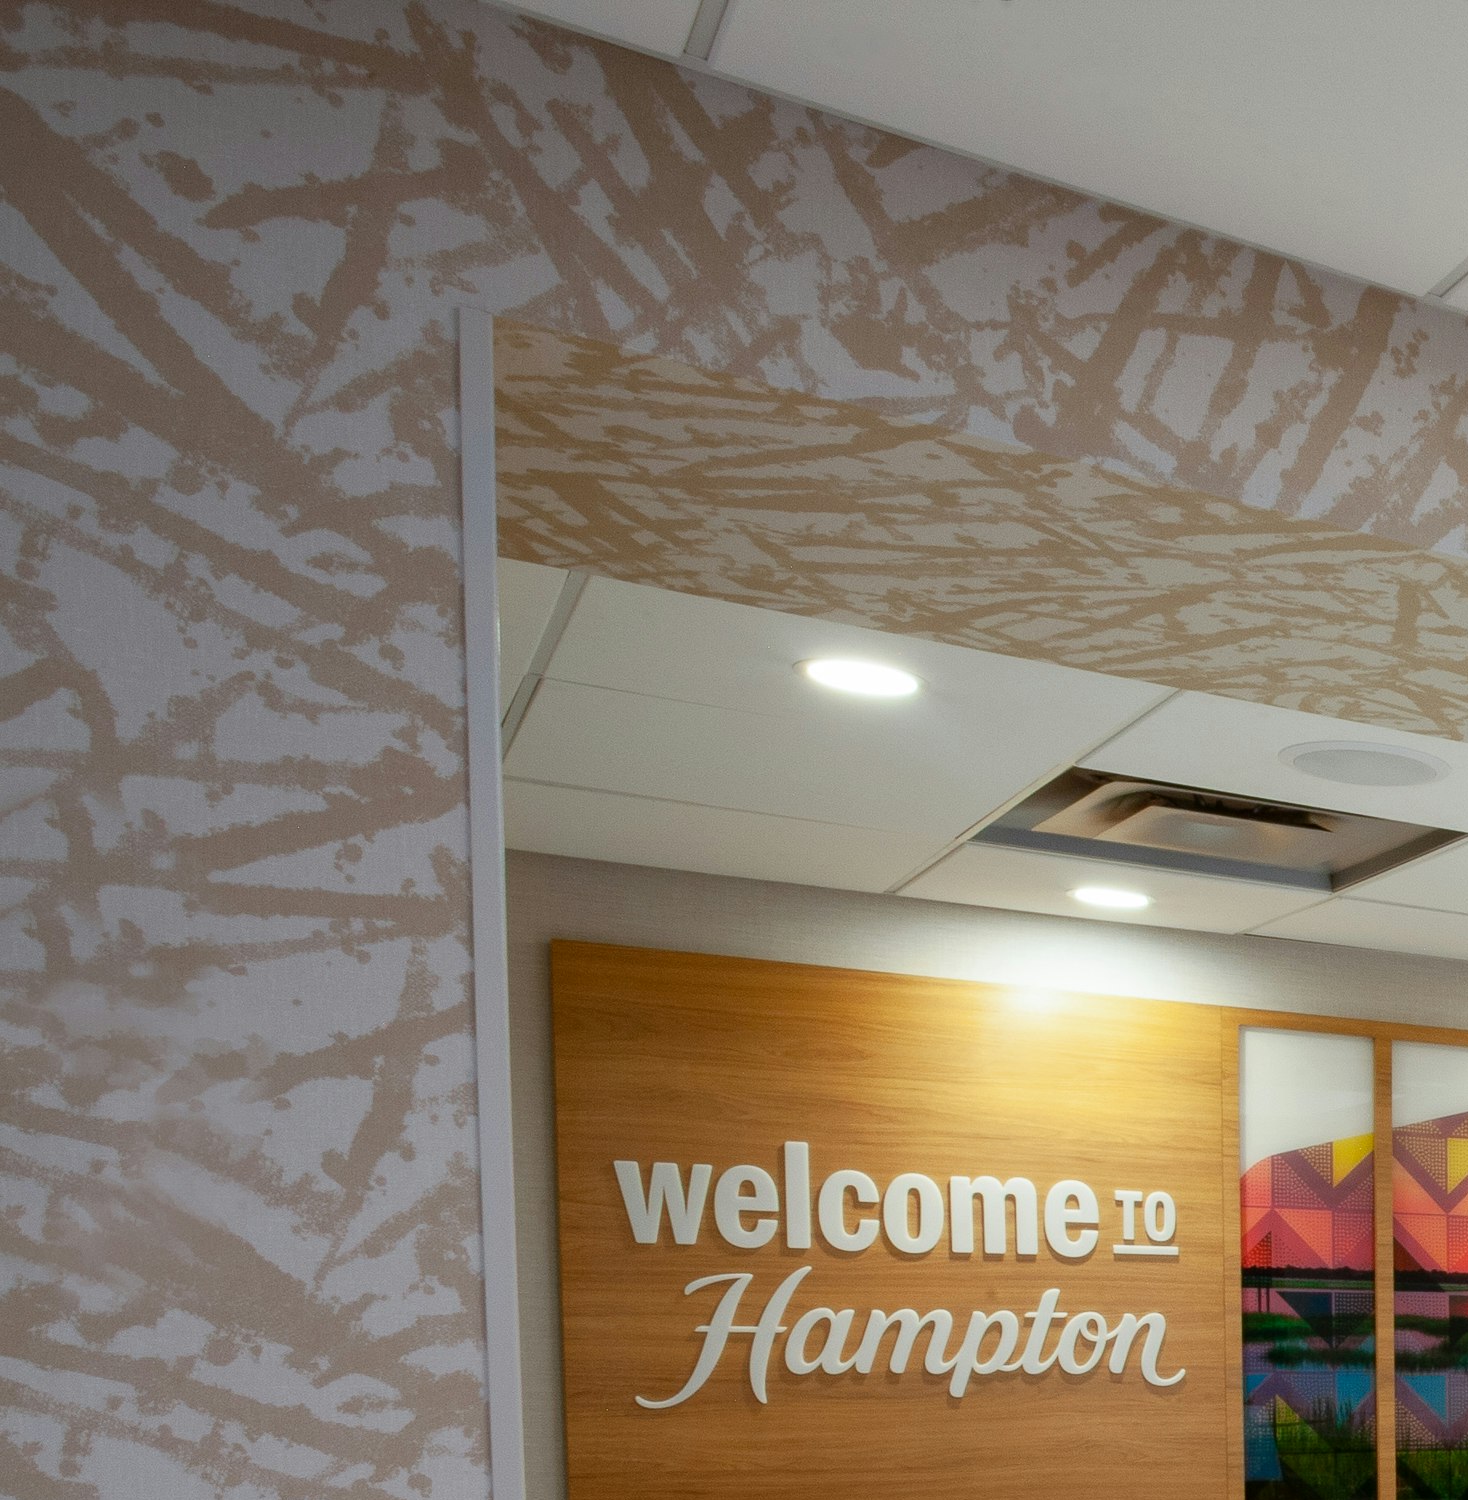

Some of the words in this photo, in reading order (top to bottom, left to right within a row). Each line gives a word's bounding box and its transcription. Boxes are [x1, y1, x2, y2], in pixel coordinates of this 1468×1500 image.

[613, 1140, 1100, 1258] welcome
[1113, 1189, 1177, 1243] TO
[634, 1265, 1187, 1410] Hampton
